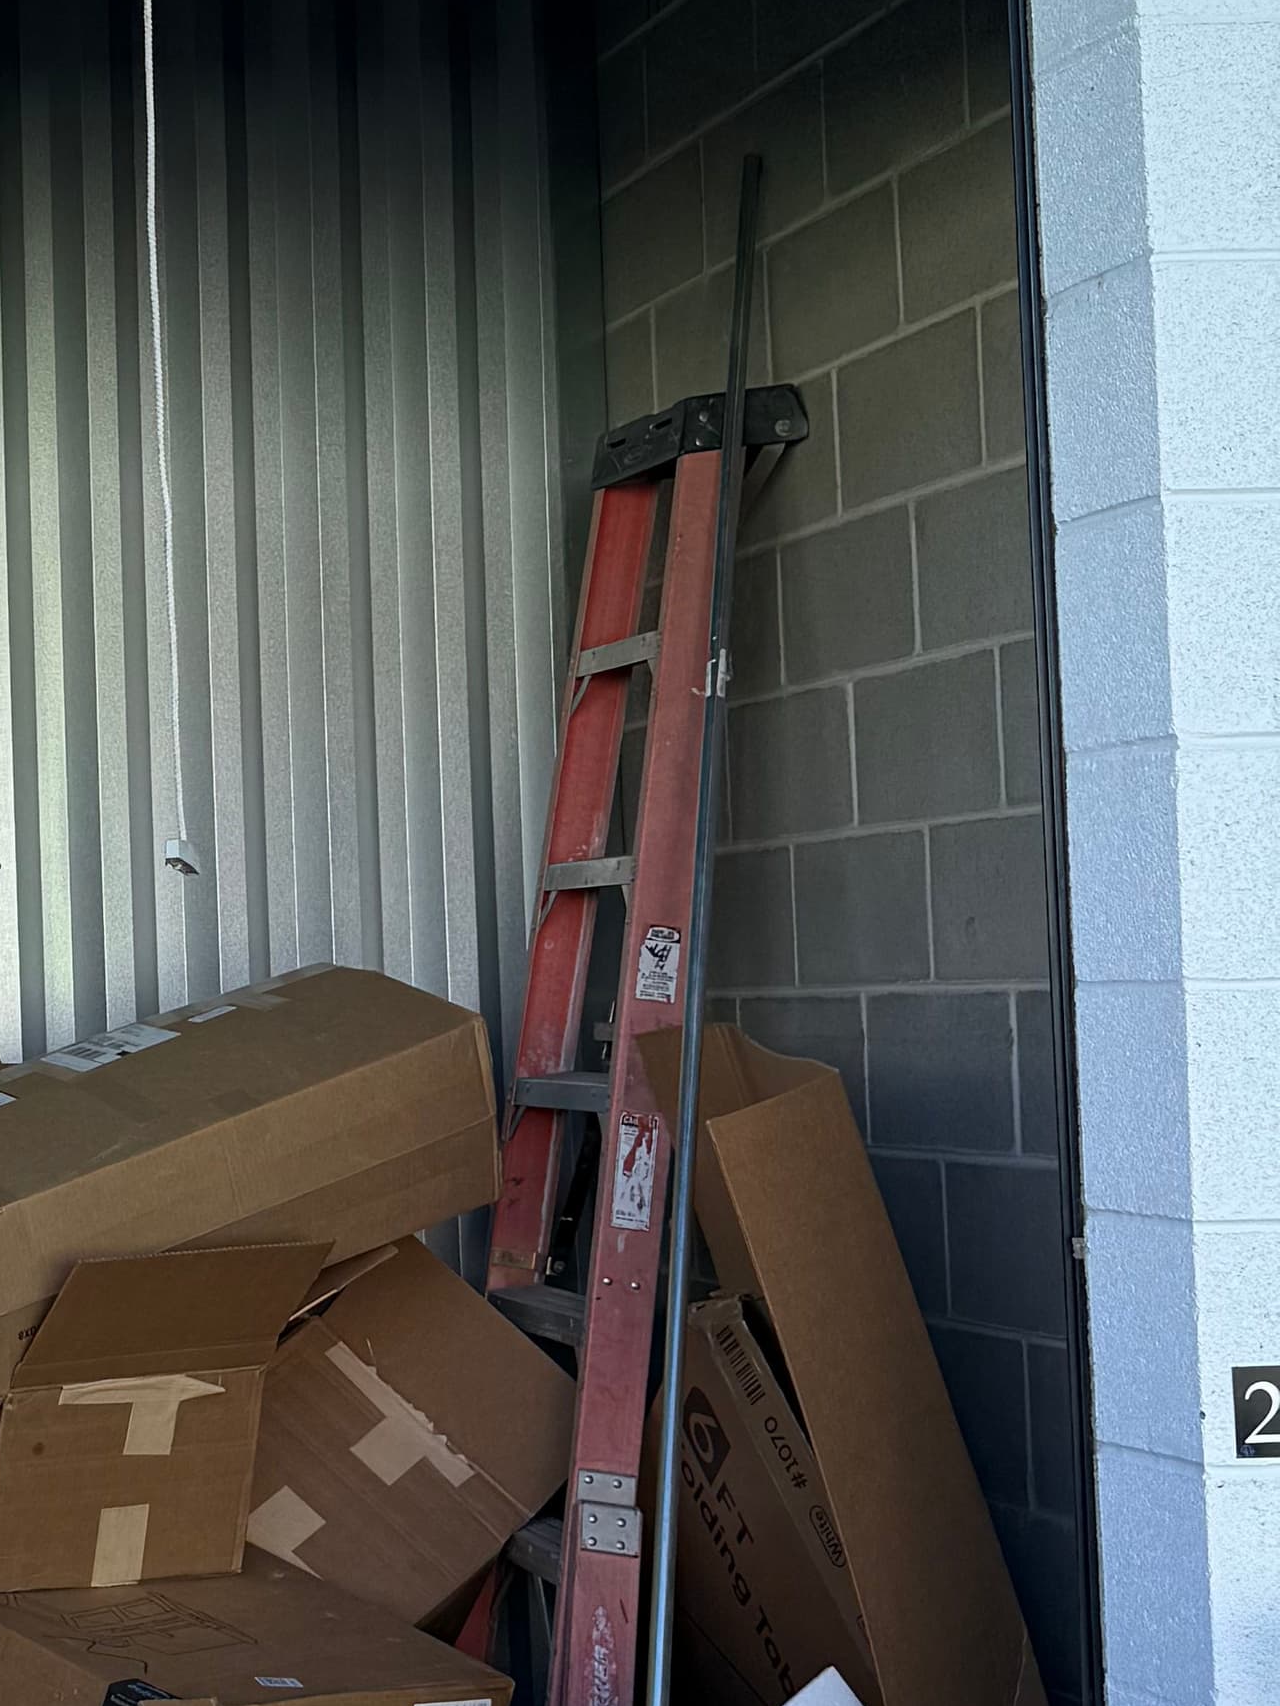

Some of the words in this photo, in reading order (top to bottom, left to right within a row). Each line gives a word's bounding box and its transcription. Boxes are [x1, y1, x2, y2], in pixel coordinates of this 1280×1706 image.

[763, 1415, 809, 1491] #1070
[680, 1459, 751, 1608] olding
[814, 1510, 843, 1563] White
